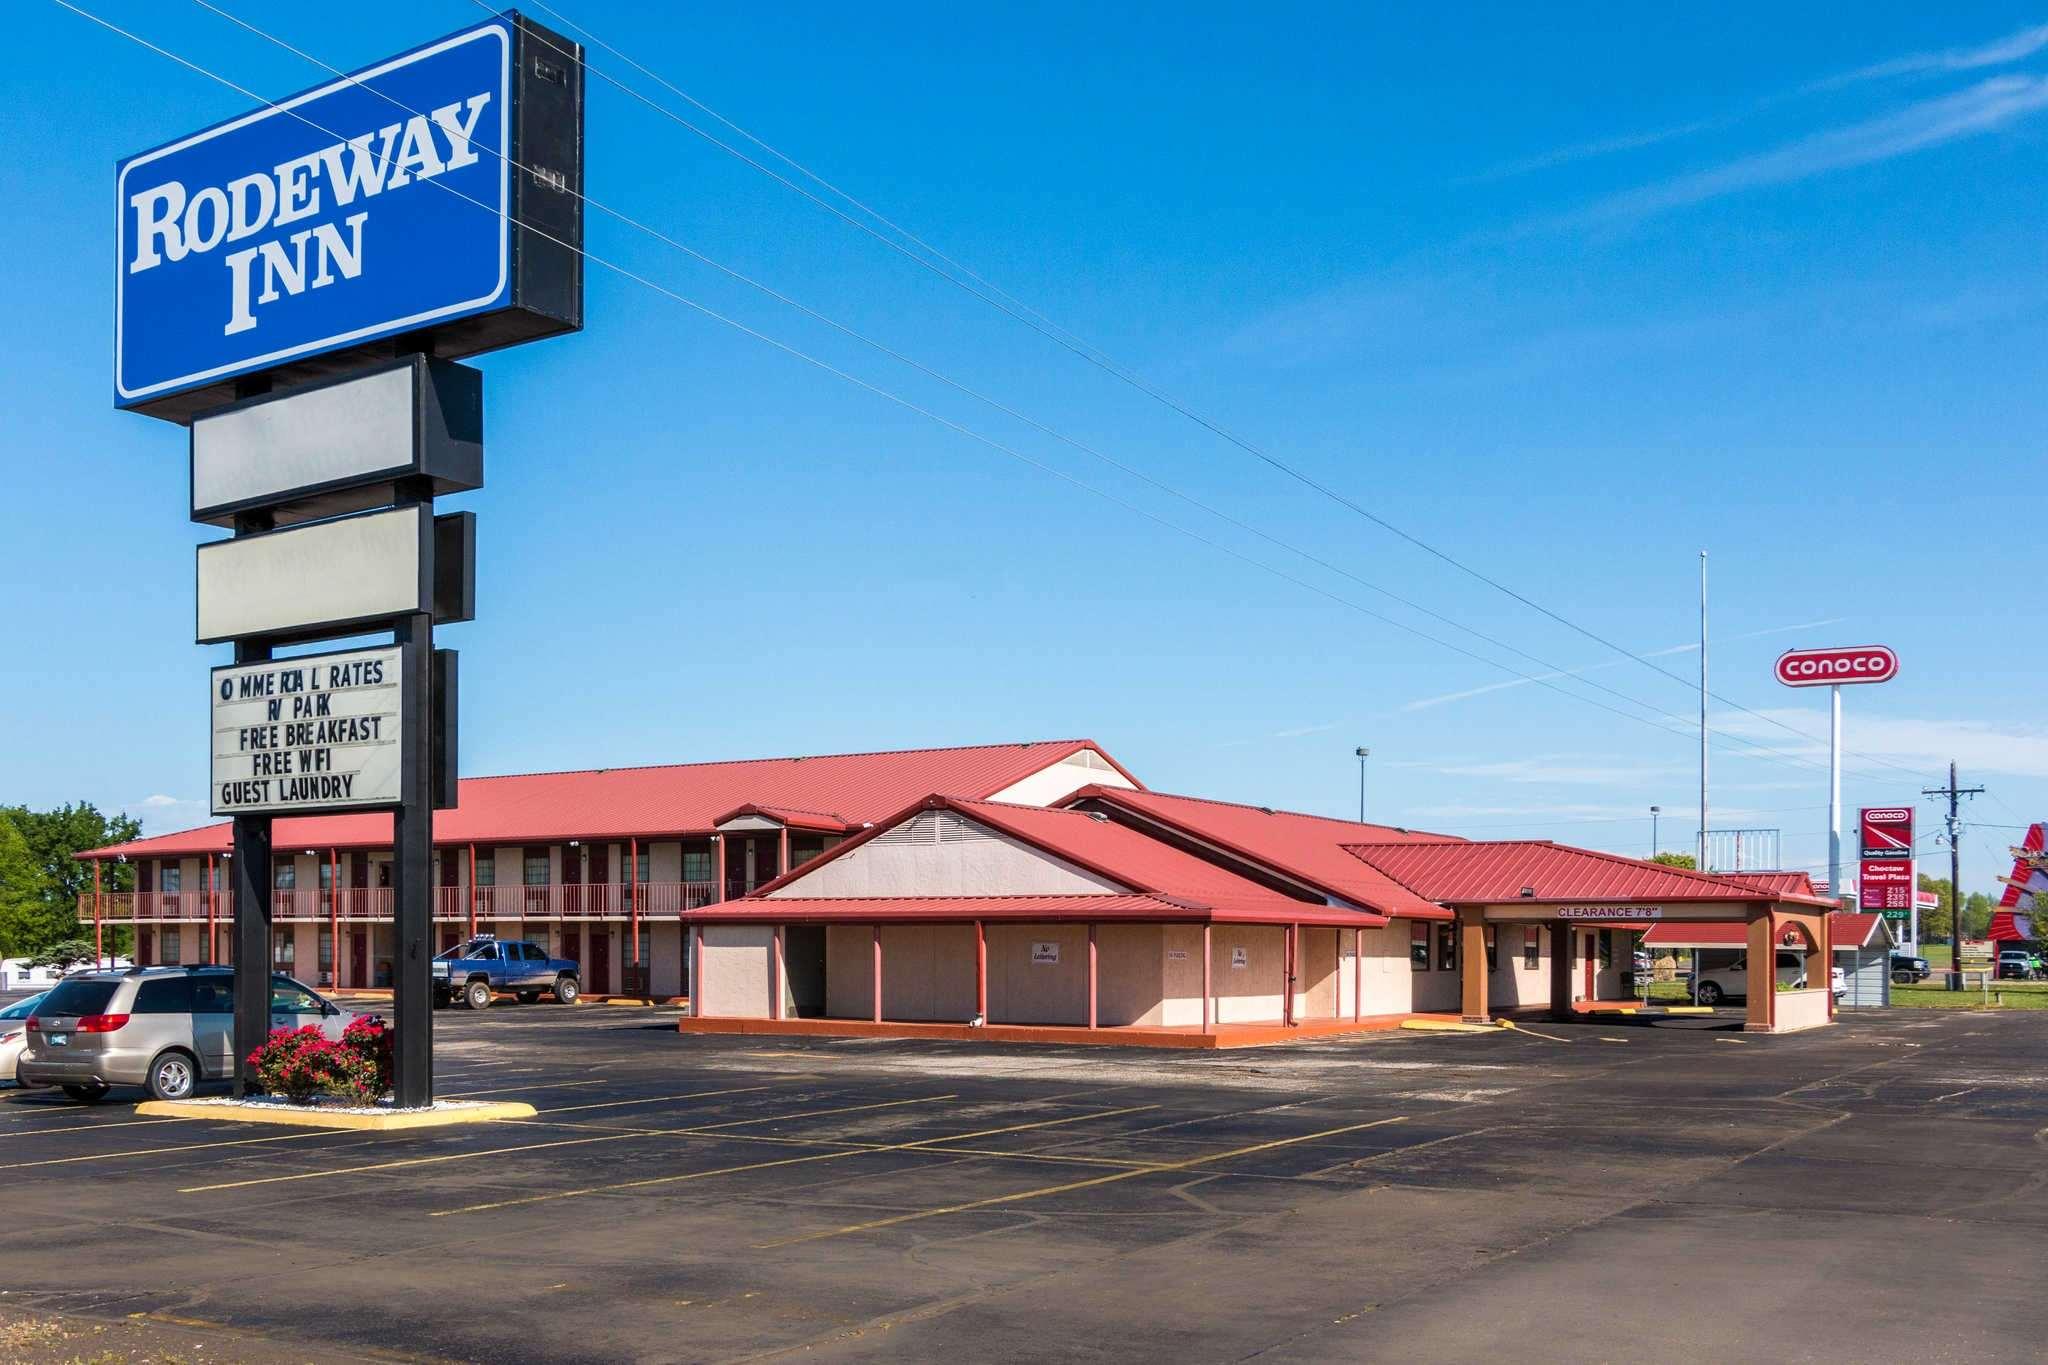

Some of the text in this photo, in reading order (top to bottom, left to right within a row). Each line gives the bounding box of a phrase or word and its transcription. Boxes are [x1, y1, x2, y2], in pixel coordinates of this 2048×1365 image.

[130, 92, 491, 274] RODEWAY
[224, 212, 368, 336] INN
[329, 660, 384, 688] RATES
[293, 692, 332, 719] PARK
[240, 716, 382, 751] FREE BREAKFAST
[253, 751, 292, 776] FREE
[222, 774, 354, 805] GUEST LAUNDRY
[1558, 907, 1633, 917] CLEARANCE
